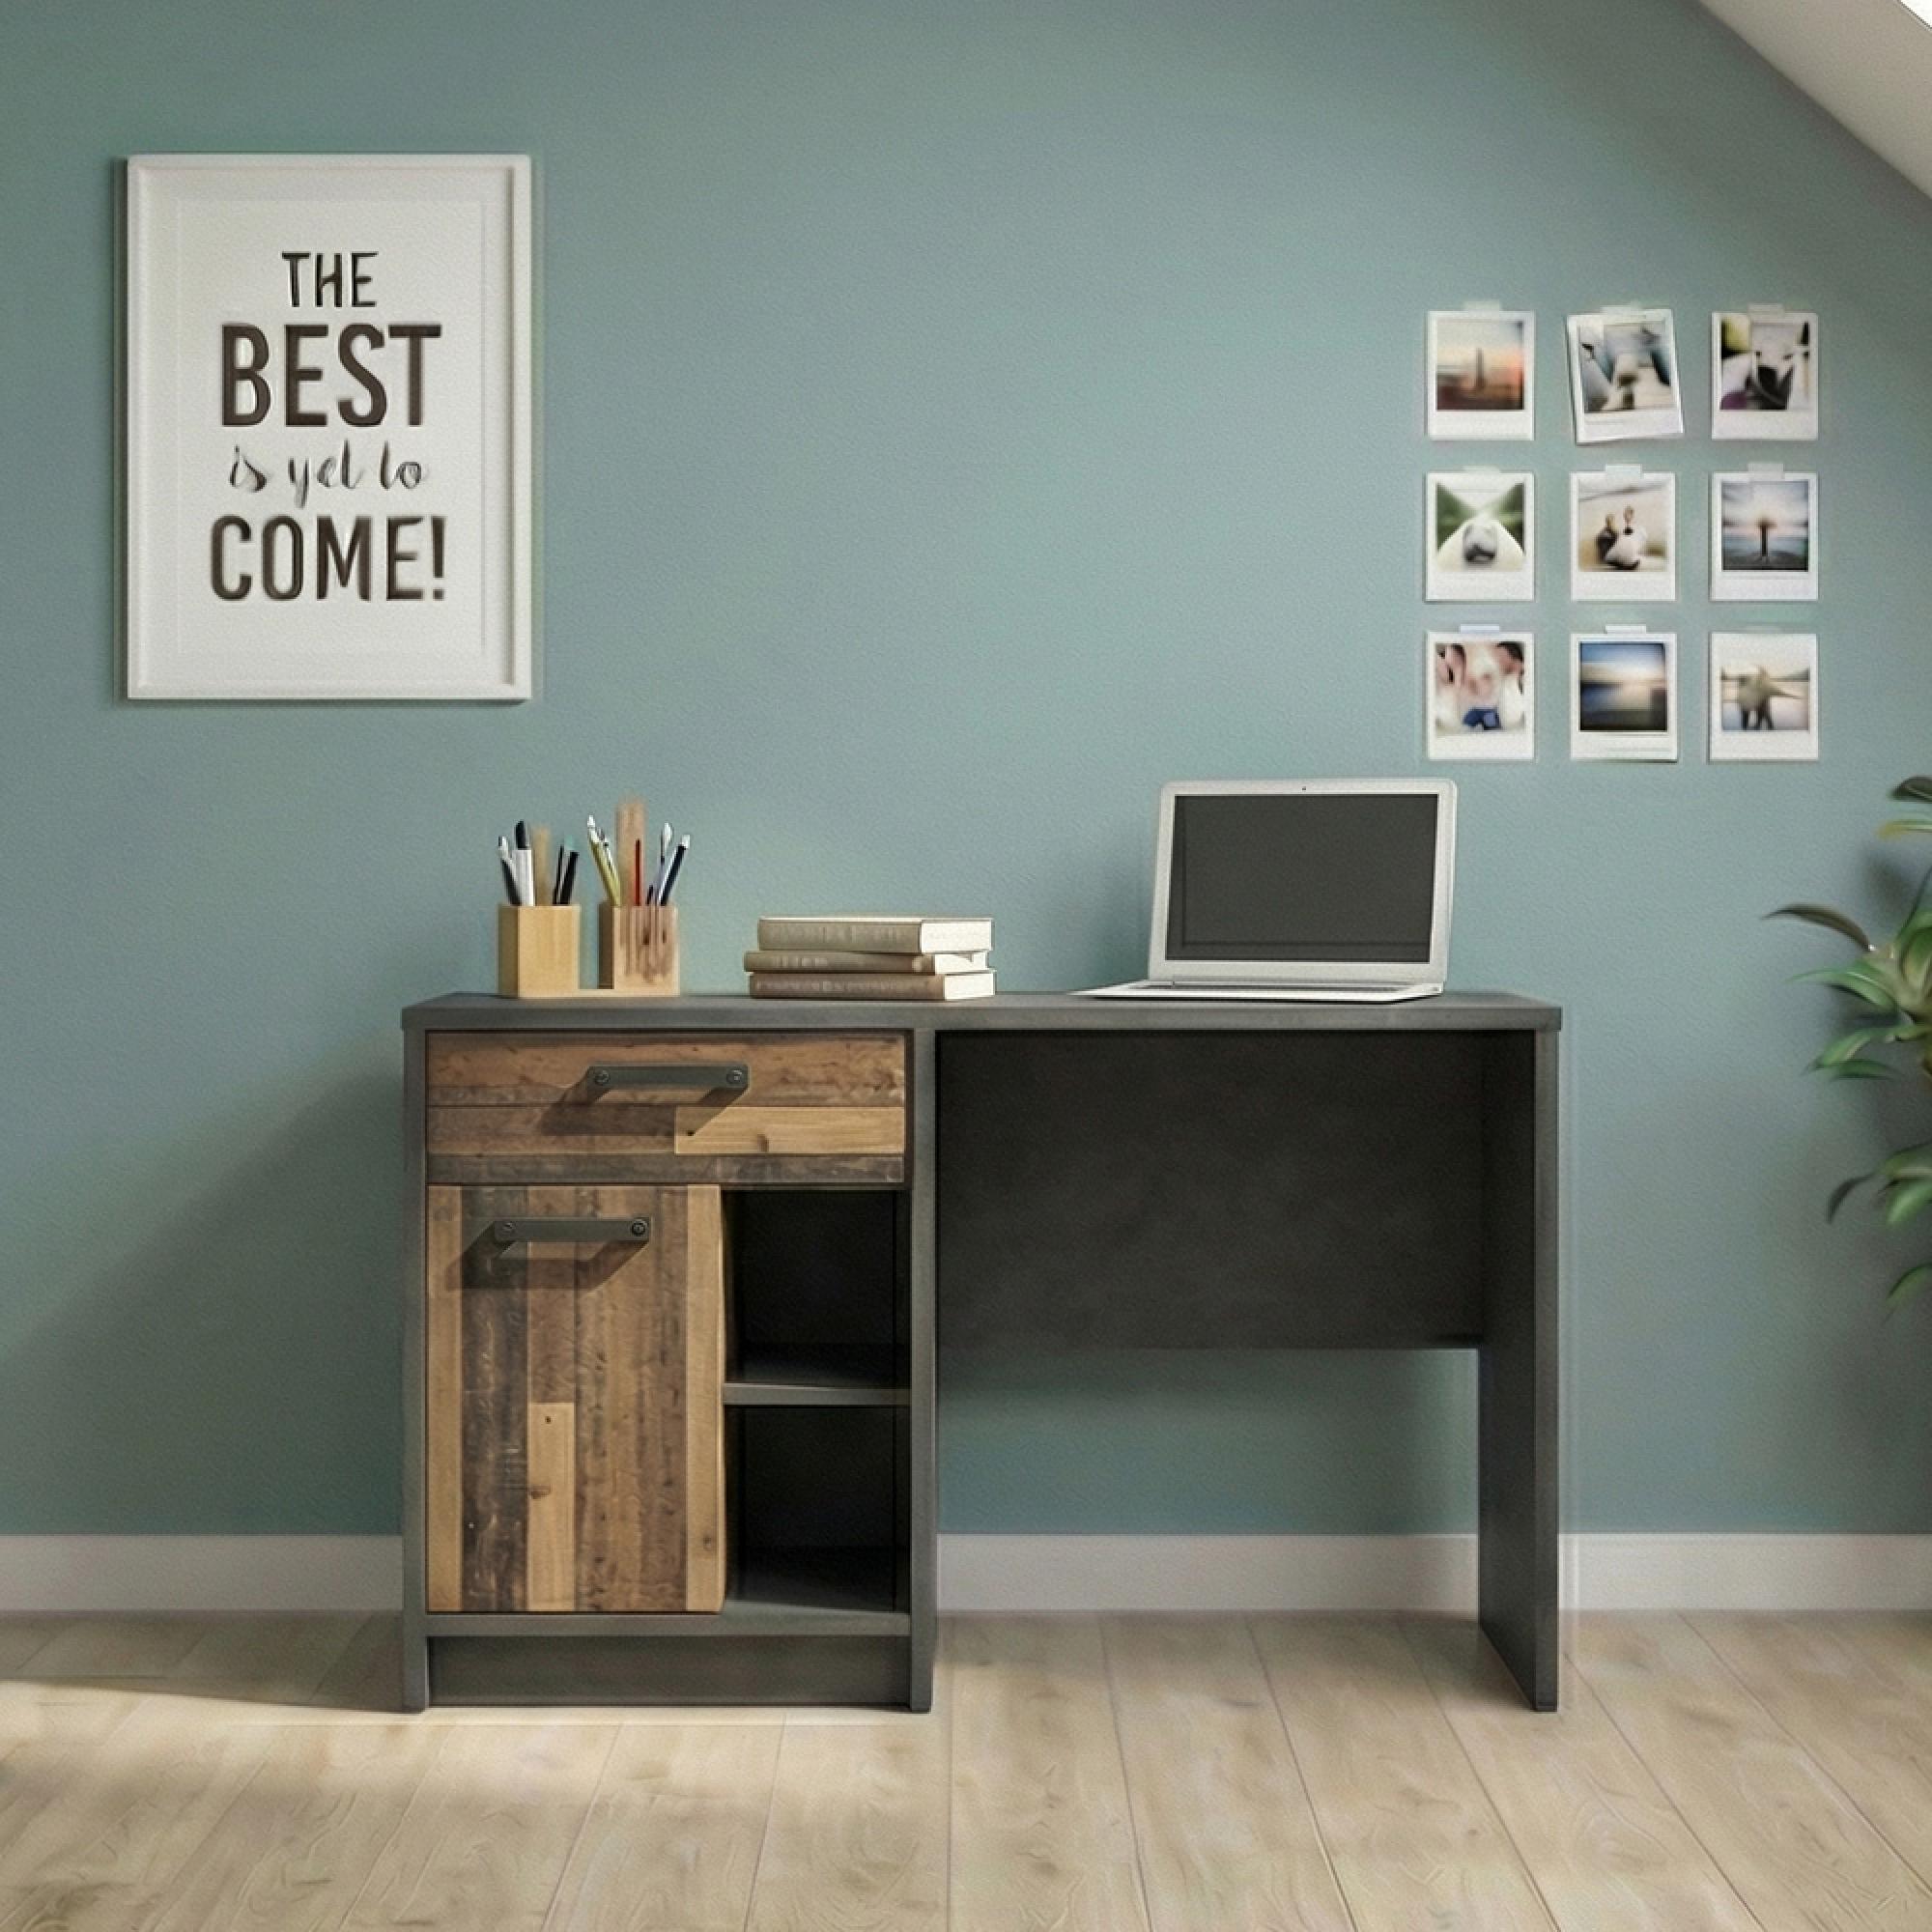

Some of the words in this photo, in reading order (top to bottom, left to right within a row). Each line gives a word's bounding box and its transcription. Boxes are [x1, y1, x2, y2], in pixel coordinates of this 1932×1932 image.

[282, 251, 379, 308] THE
[221, 323, 441, 428] BEST
[229, 445, 268, 493] is
[210, 515, 446, 602] COME!
